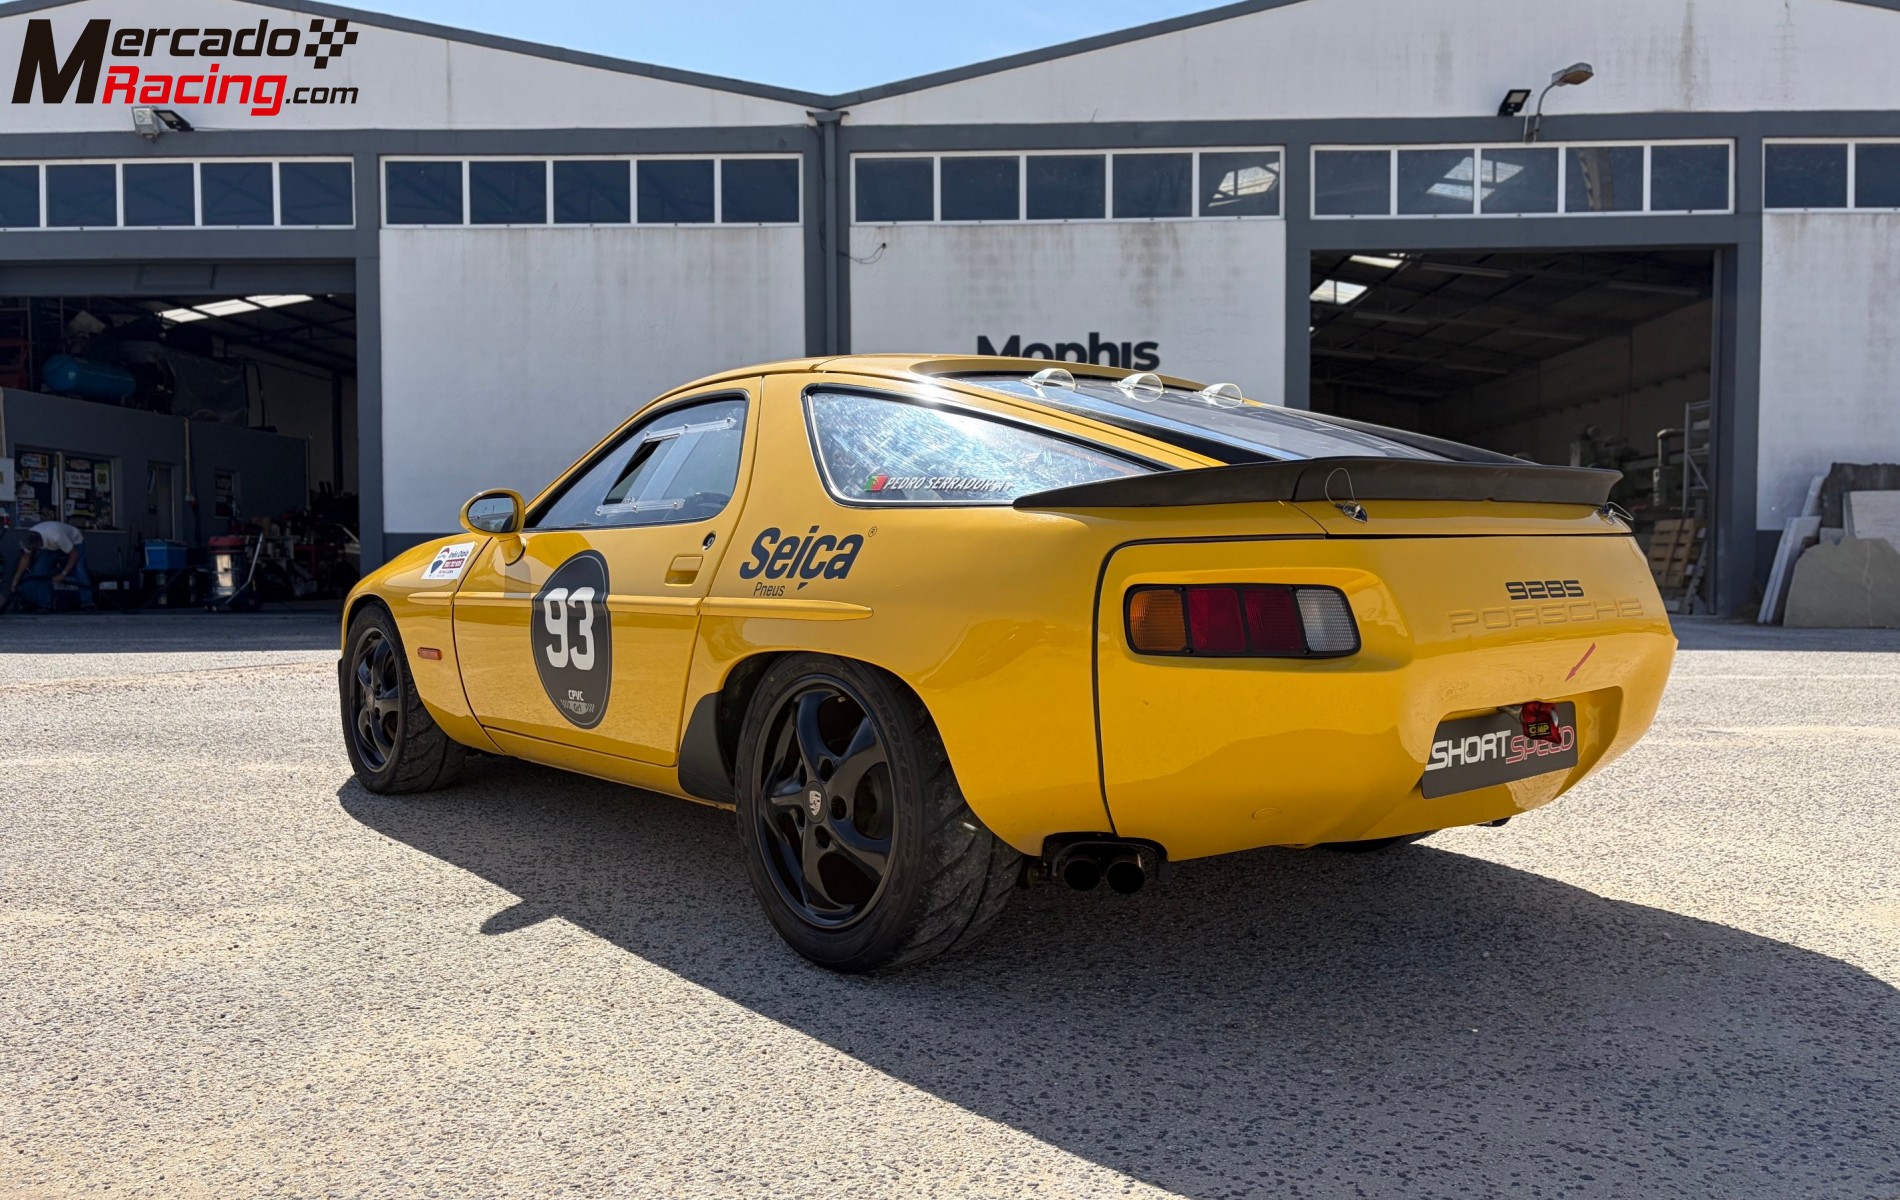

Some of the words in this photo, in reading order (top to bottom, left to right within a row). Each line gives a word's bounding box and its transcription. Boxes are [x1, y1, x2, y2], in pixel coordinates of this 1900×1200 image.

[883, 476, 926, 490] PEDRO
[924, 477, 993, 491] SERRADOR
[739, 525, 864, 591] Seiça
[753, 581, 786, 597] Pneus
[543, 586, 596, 671] 93
[1448, 598, 1644, 633] PORSCHE
[568, 689, 584, 701] CPVC
[1425, 729, 1512, 771] SHORT
